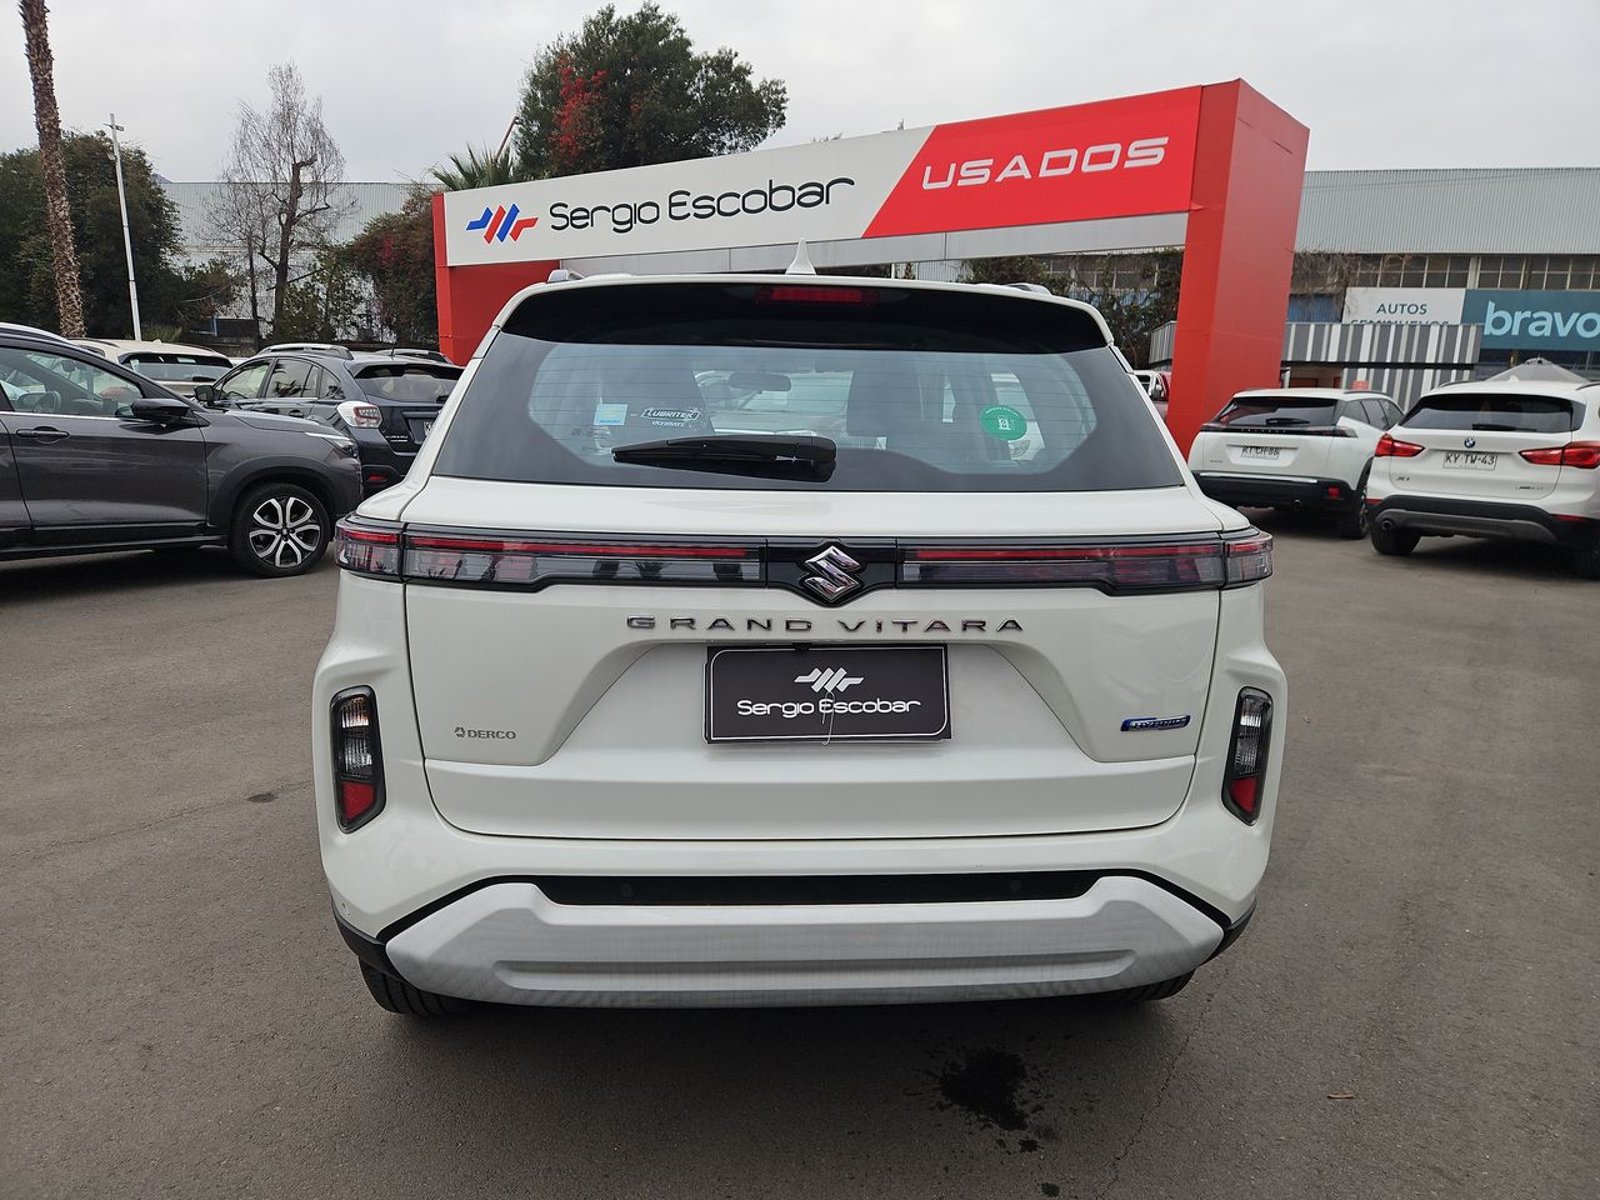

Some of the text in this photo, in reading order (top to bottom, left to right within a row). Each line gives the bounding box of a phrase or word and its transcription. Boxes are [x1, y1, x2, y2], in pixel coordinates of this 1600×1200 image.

[921, 136, 1170, 191] USADOS
[549, 177, 856, 234] Sergio Escobar
[1376, 303, 1428, 316] AUTOS
[627, 615, 1024, 632] GRAND VITARA
[736, 699, 921, 719] Sergio Escobar
[467, 729, 517, 740] DERCO
